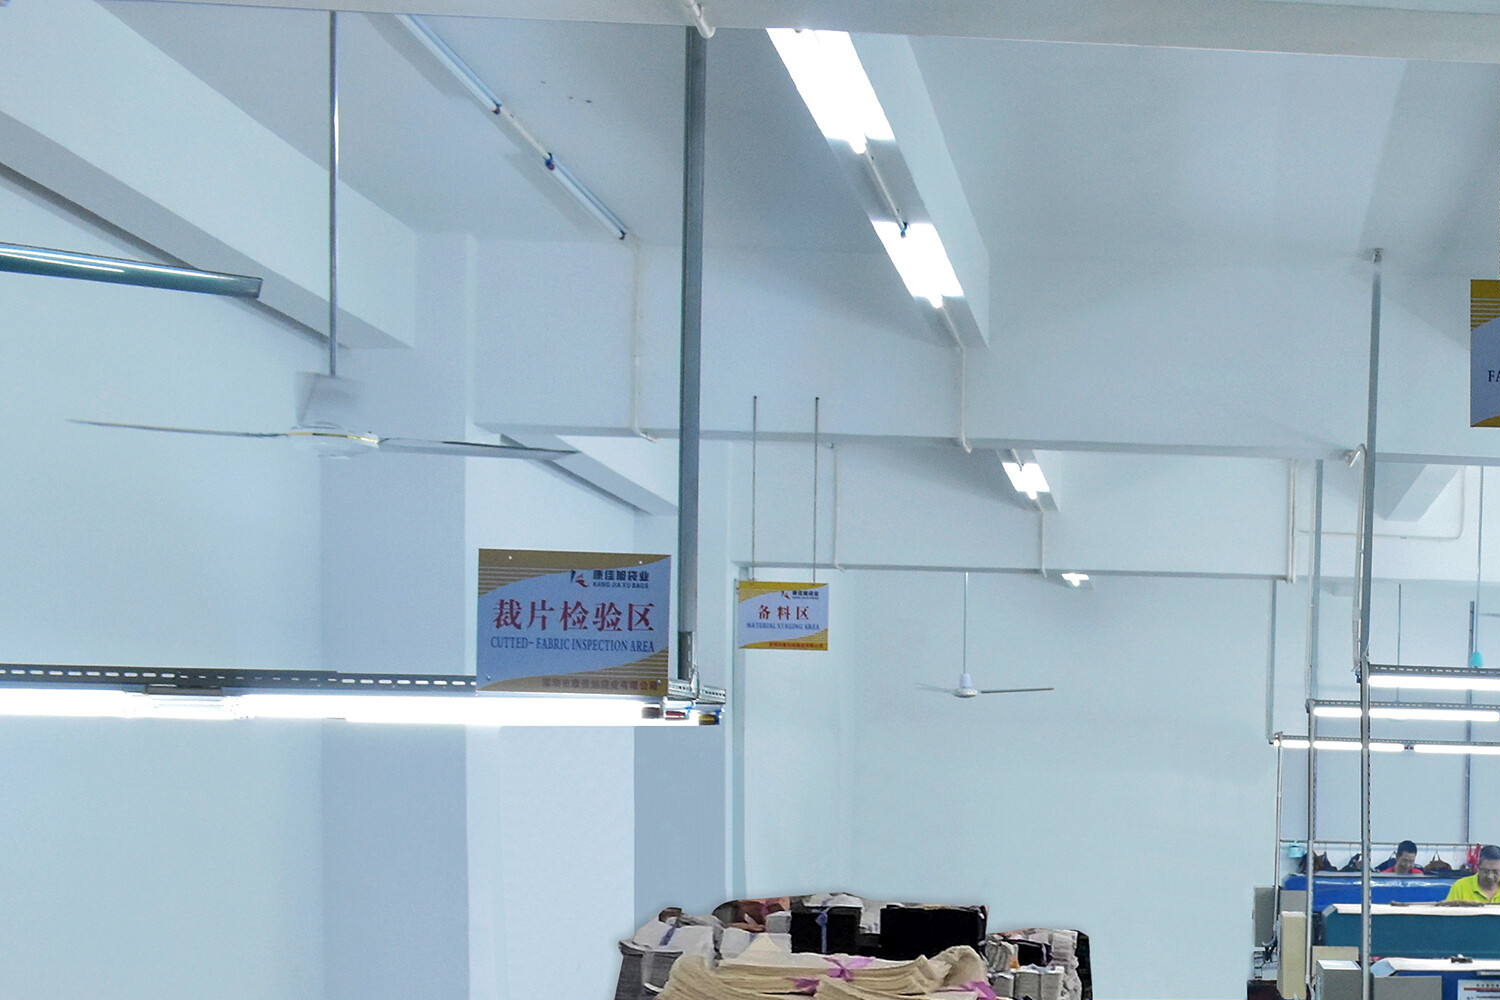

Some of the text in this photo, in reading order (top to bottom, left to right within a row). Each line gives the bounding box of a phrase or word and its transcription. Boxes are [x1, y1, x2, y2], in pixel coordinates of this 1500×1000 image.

[493, 598, 655, 632] 裁片检验区
[758, 604, 809, 621] 备料区
[536, 637, 571, 650] FABRIC
[571, 638, 628, 651] INSPECTION
[631, 639, 655, 653] AREA
